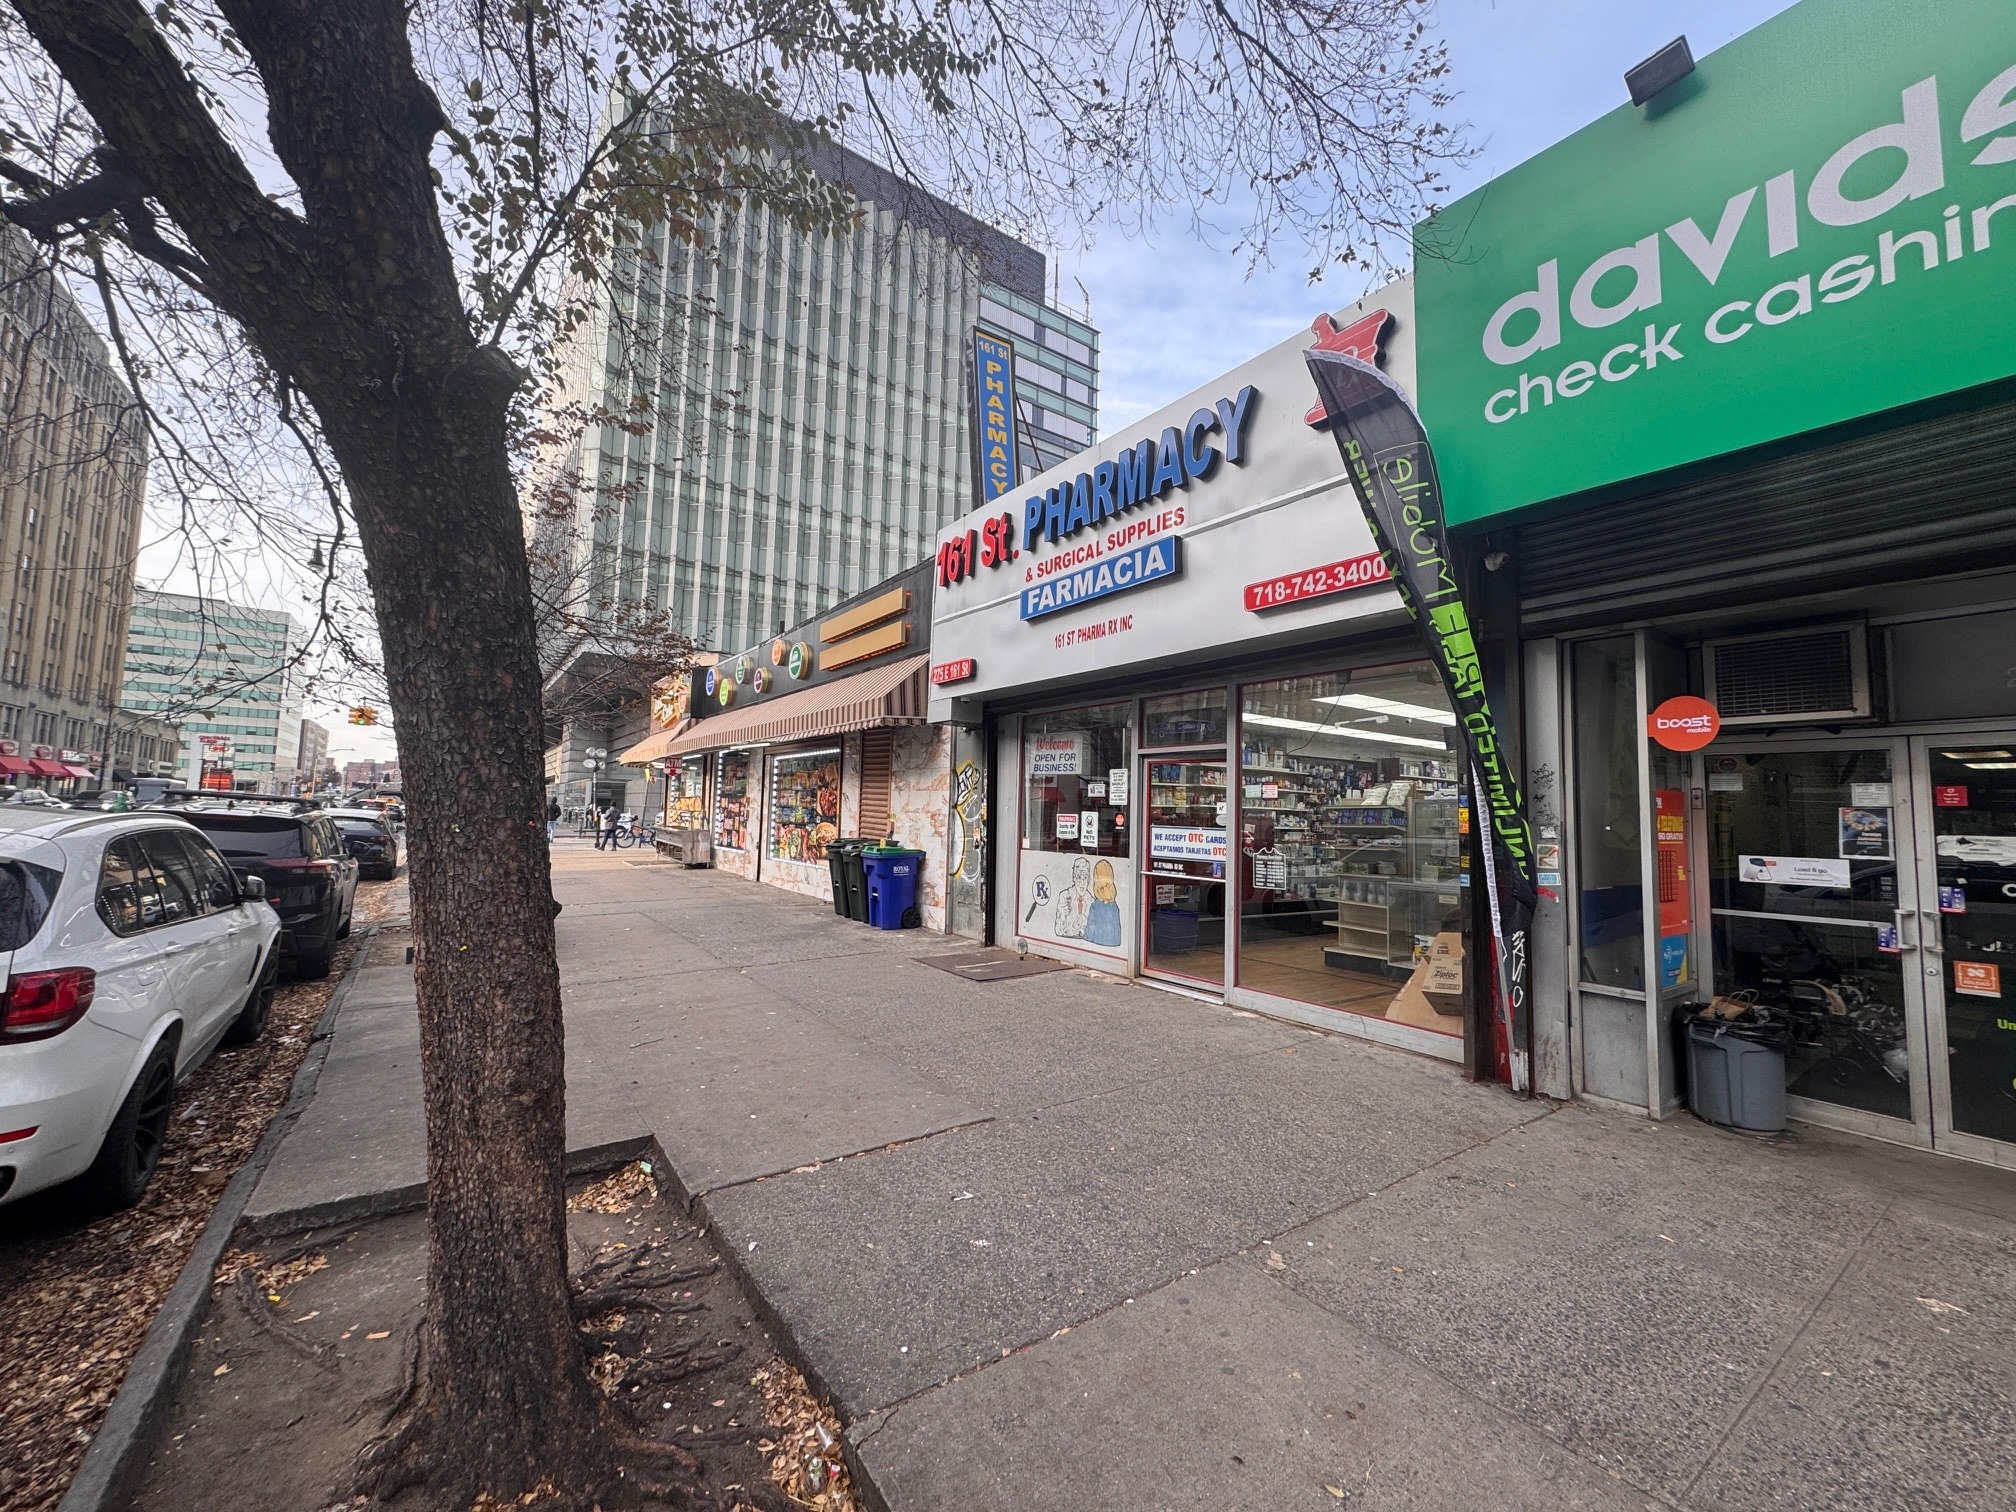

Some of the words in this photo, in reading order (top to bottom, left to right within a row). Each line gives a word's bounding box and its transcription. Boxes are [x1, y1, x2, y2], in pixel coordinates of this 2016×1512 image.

[978, 340, 995, 355] 161
[998, 347, 1008, 360] St
[1484, 323, 1683, 424] check
[986, 359, 1009, 495] PHARMACY
[936, 528, 977, 587] 161
[981, 511, 1019, 568] St.
[1023, 385, 1259, 551] PHARMACY
[1025, 567, 1033, 583] &
[1037, 540, 1104, 580] SURGICAL
[1107, 506, 1186, 548] SUPPLIES
[1026, 542, 1168, 616] FARMACIA
[1252, 554, 1386, 606] 718-742-3400
[1054, 633, 1065, 649] 161
[1066, 630, 1076, 646] ST
[1077, 622, 1106, 644] PHARMA
[1108, 618, 1119, 636] RX
[1120, 614, 1133, 632] INC
[933, 666, 944, 682] 275
[950, 662, 960, 678] 161
[962, 660, 969, 676] St
[1657, 714, 1712, 729] boost
[1686, 726, 1712, 734] mobile
[1036, 736, 1075, 751] Welcome
[665, 758, 682, 768] ATM
[1034, 754, 1056, 762] OPEN
[1059, 752, 1076, 762] FOR
[1034, 763, 1077, 772] BUSINESS!
[1164, 834, 1187, 842] ACCEPT
[1188, 833, 1204, 843] OTC
[1205, 836, 1226, 844] CARDS
[1154, 845, 1184, 853] ACEPTAMOS
[1185, 847, 1211, 855] TARJETAS
[1213, 847, 1226, 856] OTC
[1434, 970, 1459, 980] Ziploc
